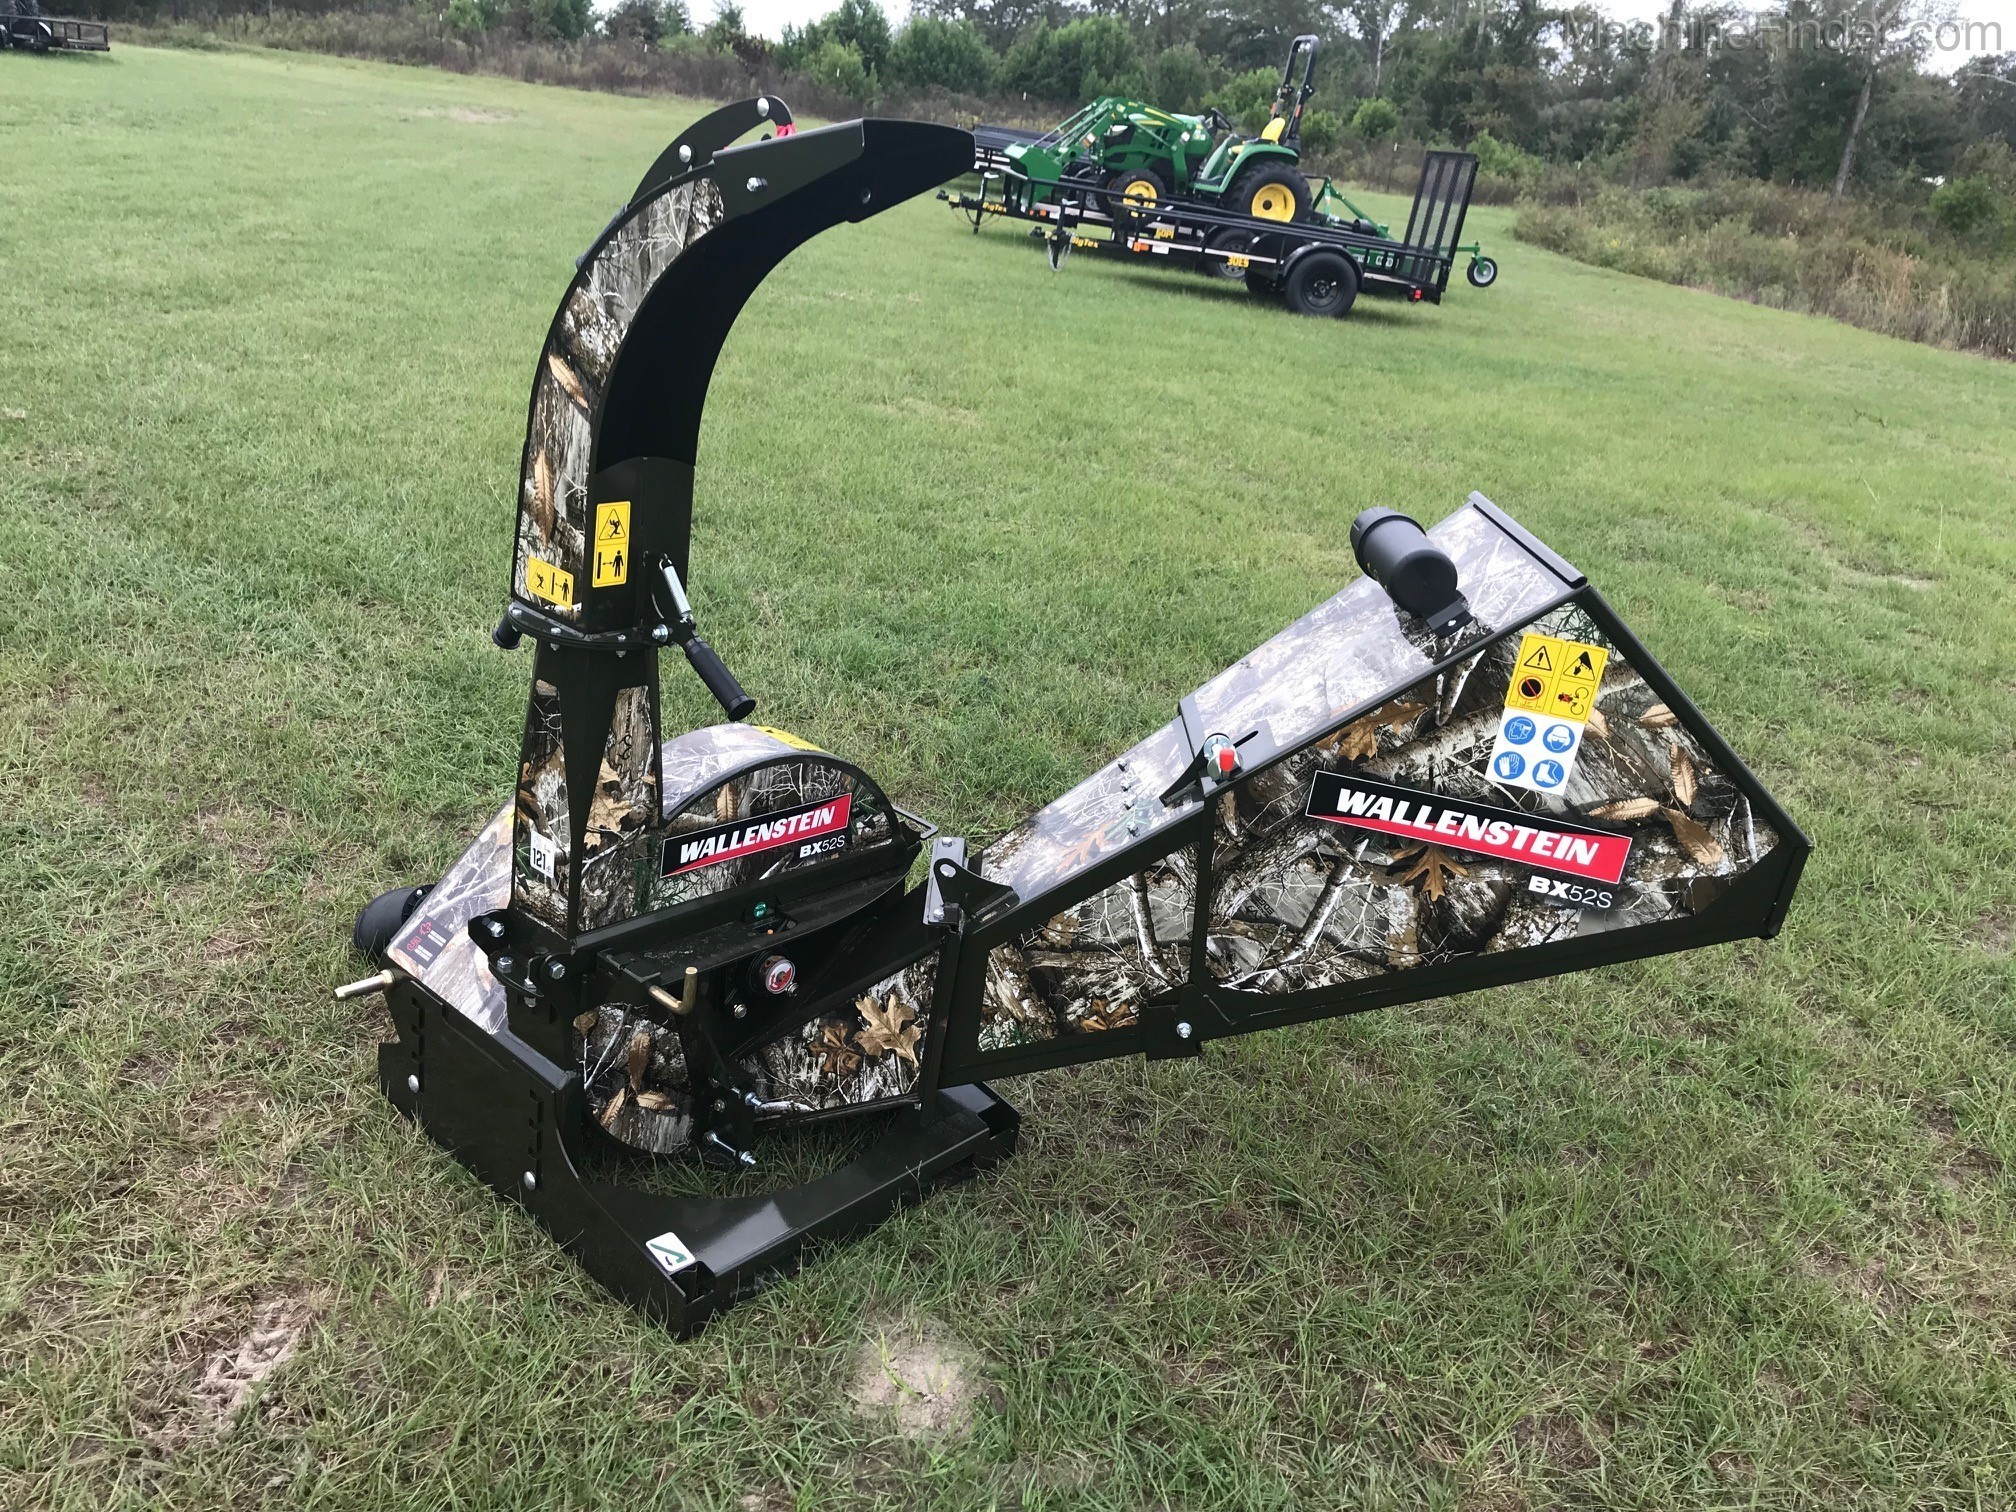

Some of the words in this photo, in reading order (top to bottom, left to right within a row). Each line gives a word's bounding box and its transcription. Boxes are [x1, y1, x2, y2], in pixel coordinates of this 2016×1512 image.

[680, 805, 836, 864] WALLENSTEIN
[1336, 788, 1600, 866] WALLENSTEIN
[533, 848, 546, 870] 121
[800, 835, 847, 858] BX52S
[1528, 875, 1613, 909] BX52S
